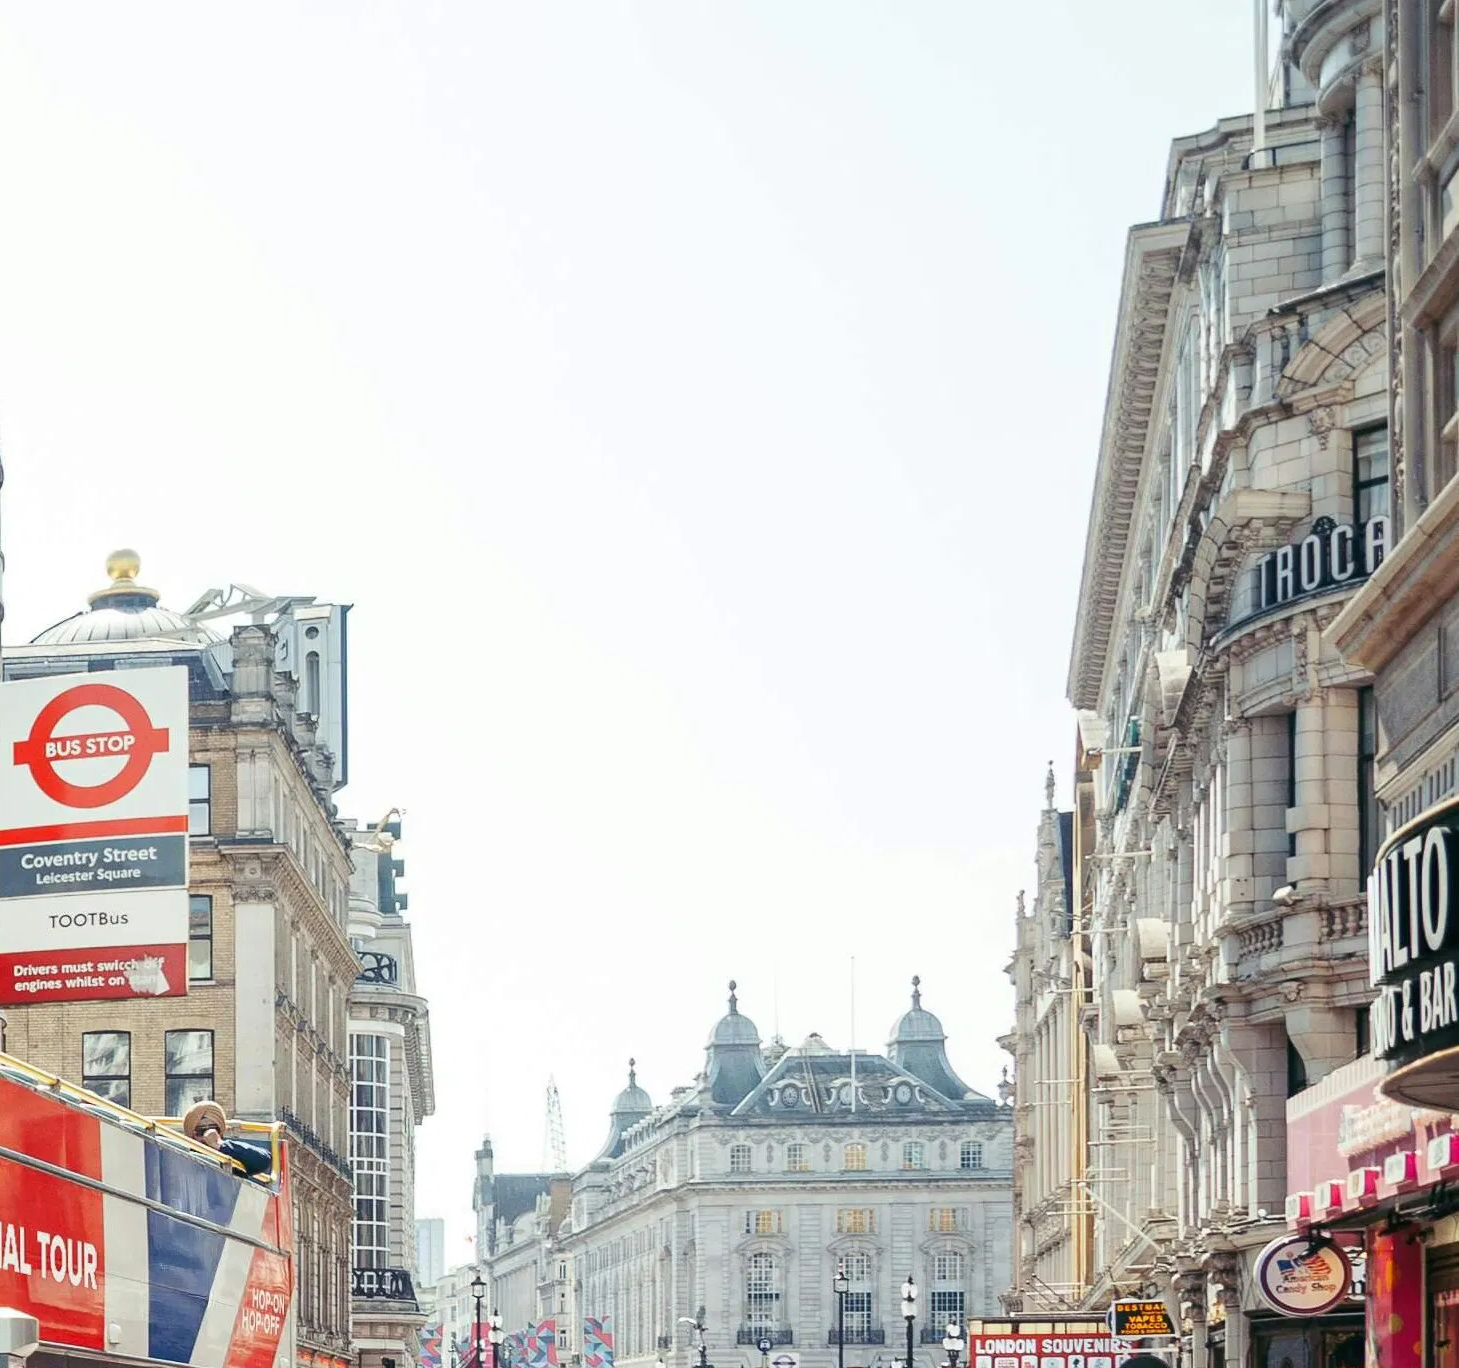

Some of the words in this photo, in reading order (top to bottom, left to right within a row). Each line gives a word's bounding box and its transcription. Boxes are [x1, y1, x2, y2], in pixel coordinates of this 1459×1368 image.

[45, 739, 80, 758] BUS
[86, 735, 135, 755] STOP
[21, 853, 98, 870] Coventry
[103, 847, 157, 863] Street
[36, 869, 94, 885] Leicester
[97, 868, 141, 882] Square
[14, 963, 57, 977] Drivers
[61, 961, 93, 974] must
[15, 978, 62, 993] engines
[66, 975, 106, 988] whilst
[108, 975, 125, 986] on
[1402, 980, 1414, 1041] &
[1420, 962, 1457, 1034] BAR
[37, 1230, 98, 1290] TOUR
[1276, 1285, 1307, 1294] Candy
[1311, 1283, 1336, 1293] Shop
[252, 1288, 285, 1315] HOP-ON
[242, 1308, 280, 1336] HOP-OFF
[975, 1339, 1036, 1354] LONDON
[1042, 1338, 1132, 1354] SOUVENIRS
